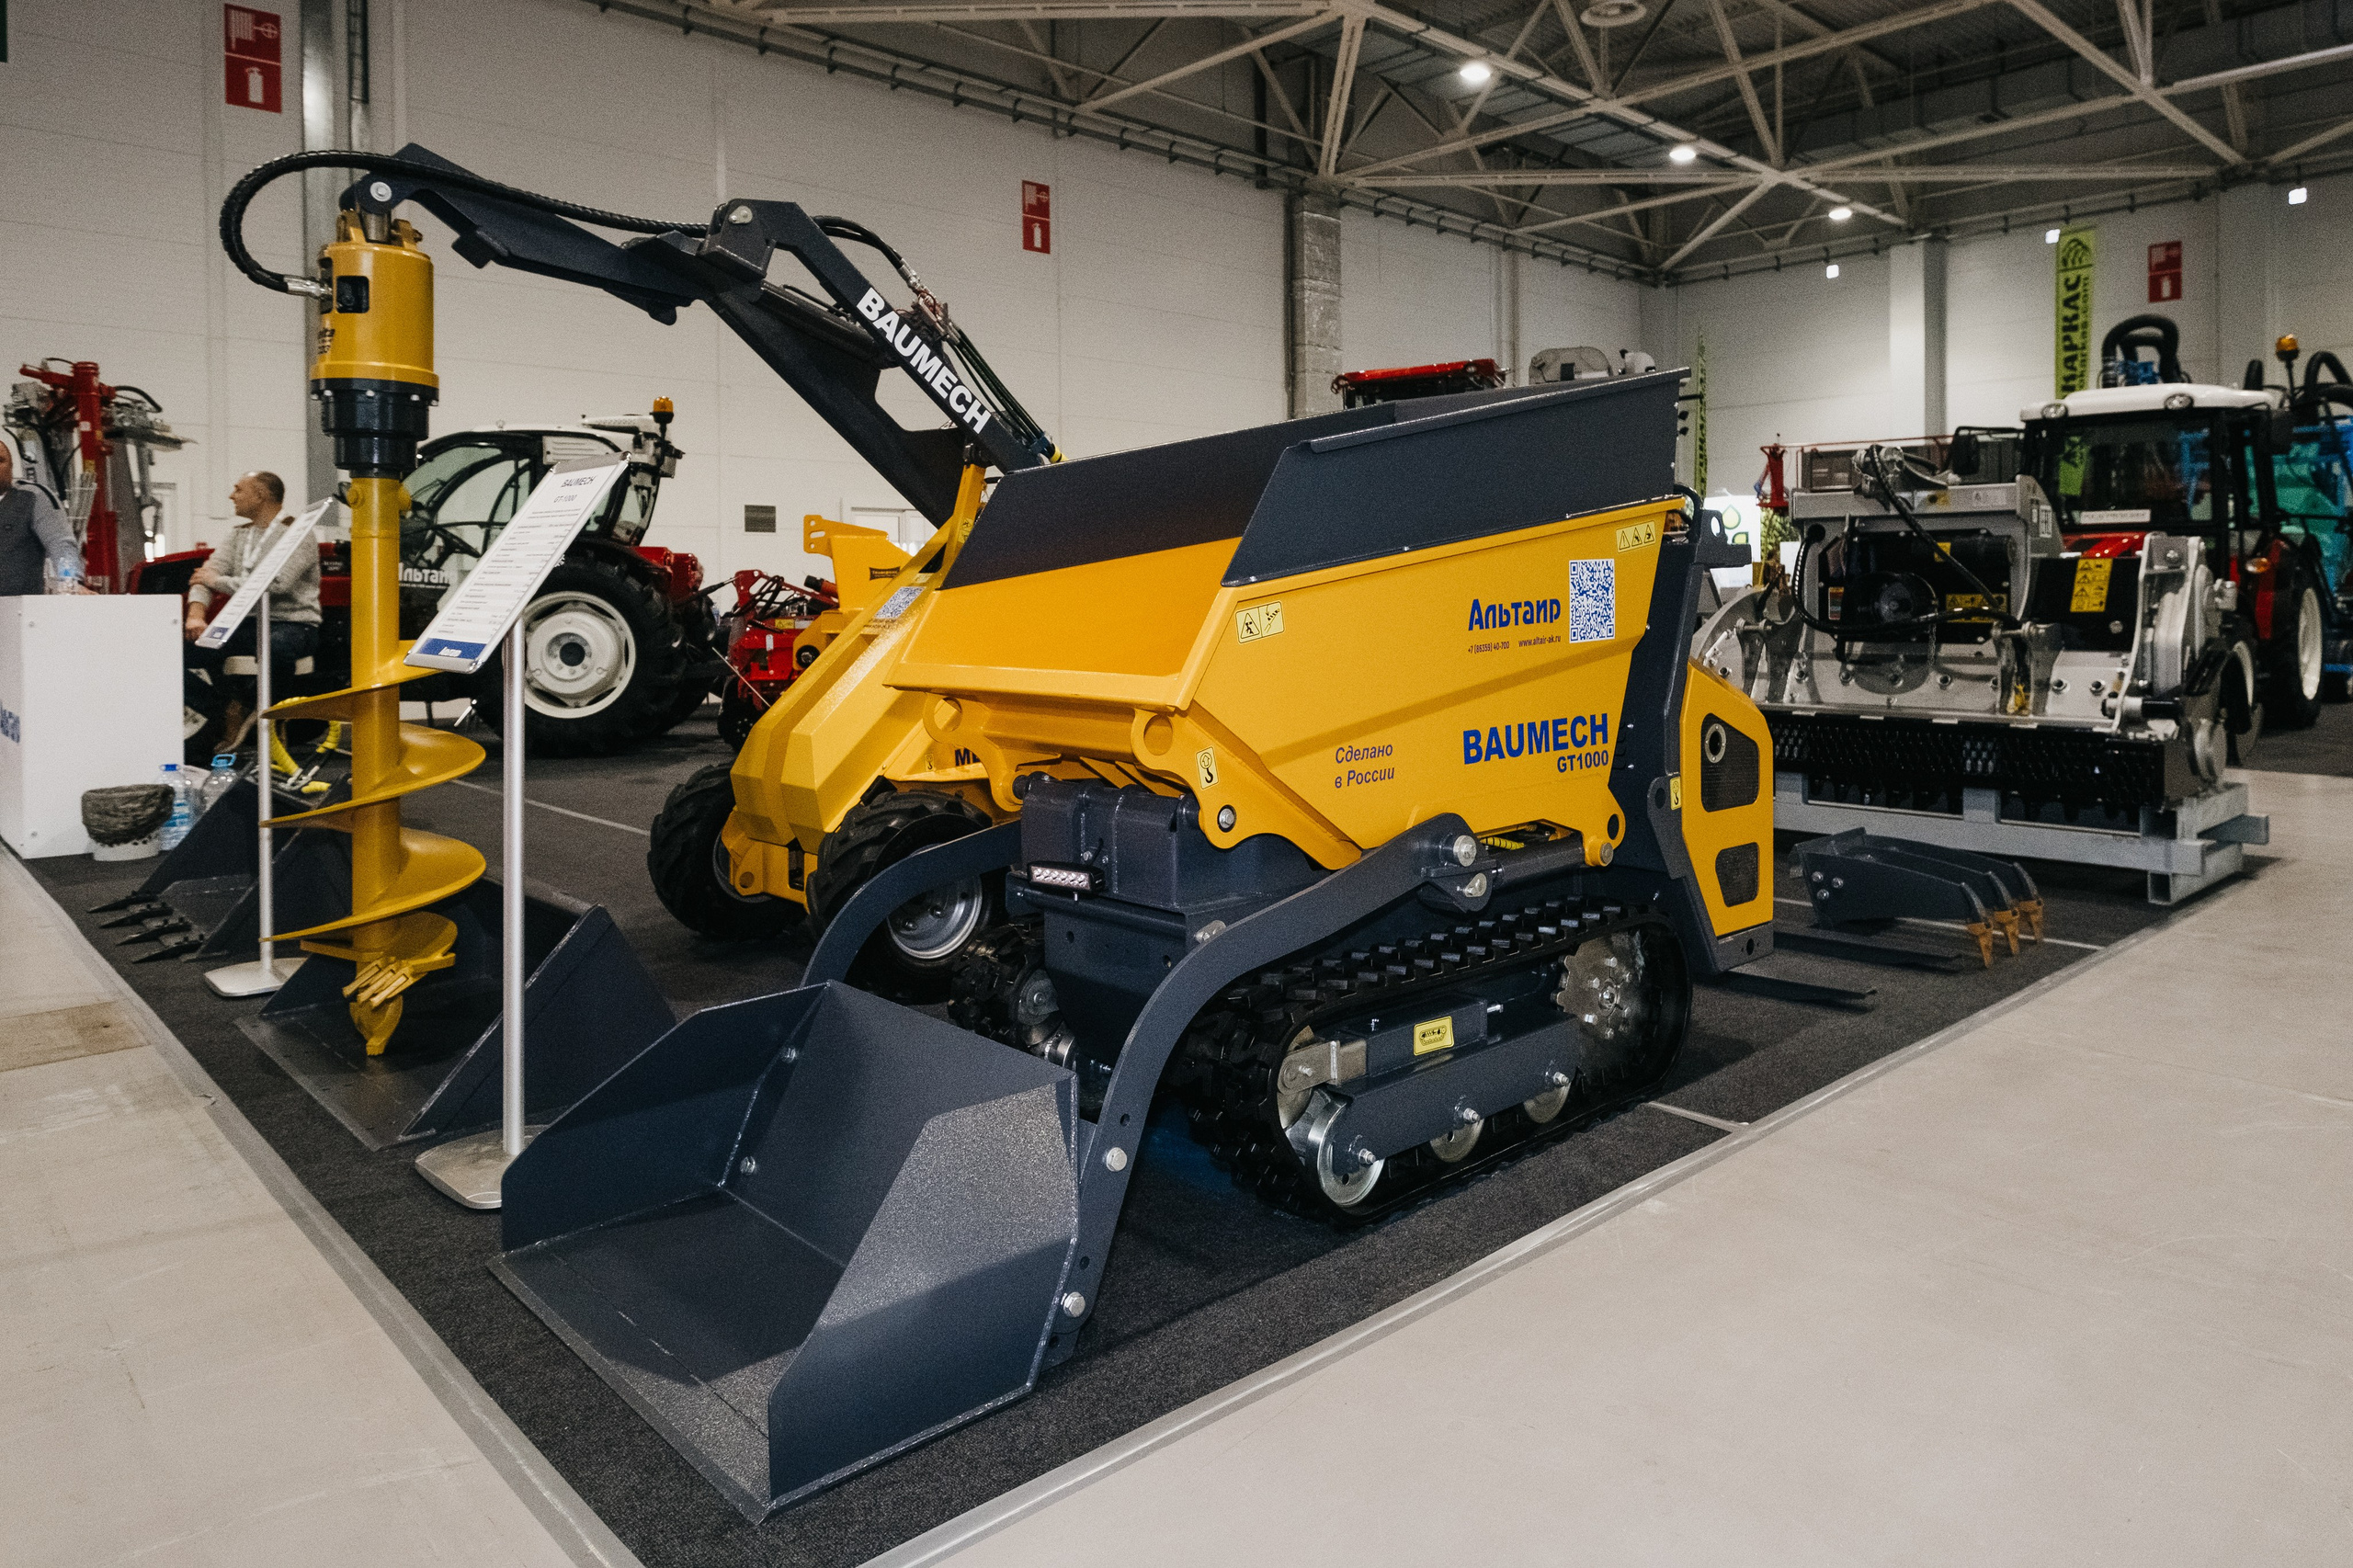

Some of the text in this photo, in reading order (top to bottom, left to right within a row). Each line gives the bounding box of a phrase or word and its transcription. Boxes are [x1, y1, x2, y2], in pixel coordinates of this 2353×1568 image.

[857, 287, 992, 435] BAUMECH
[561, 476, 597, 488] BAUMECH
[1468, 598, 1561, 631] Альтаир
[1493, 641, 1510, 651] 40-700
[1518, 634, 1562, 647] www.altair-ak.ru
[1462, 713, 1608, 765] BAUMECH
[1335, 744, 1393, 764] Сделано
[1557, 749, 1608, 773] GT1000
[1335, 767, 1395, 789] в России
